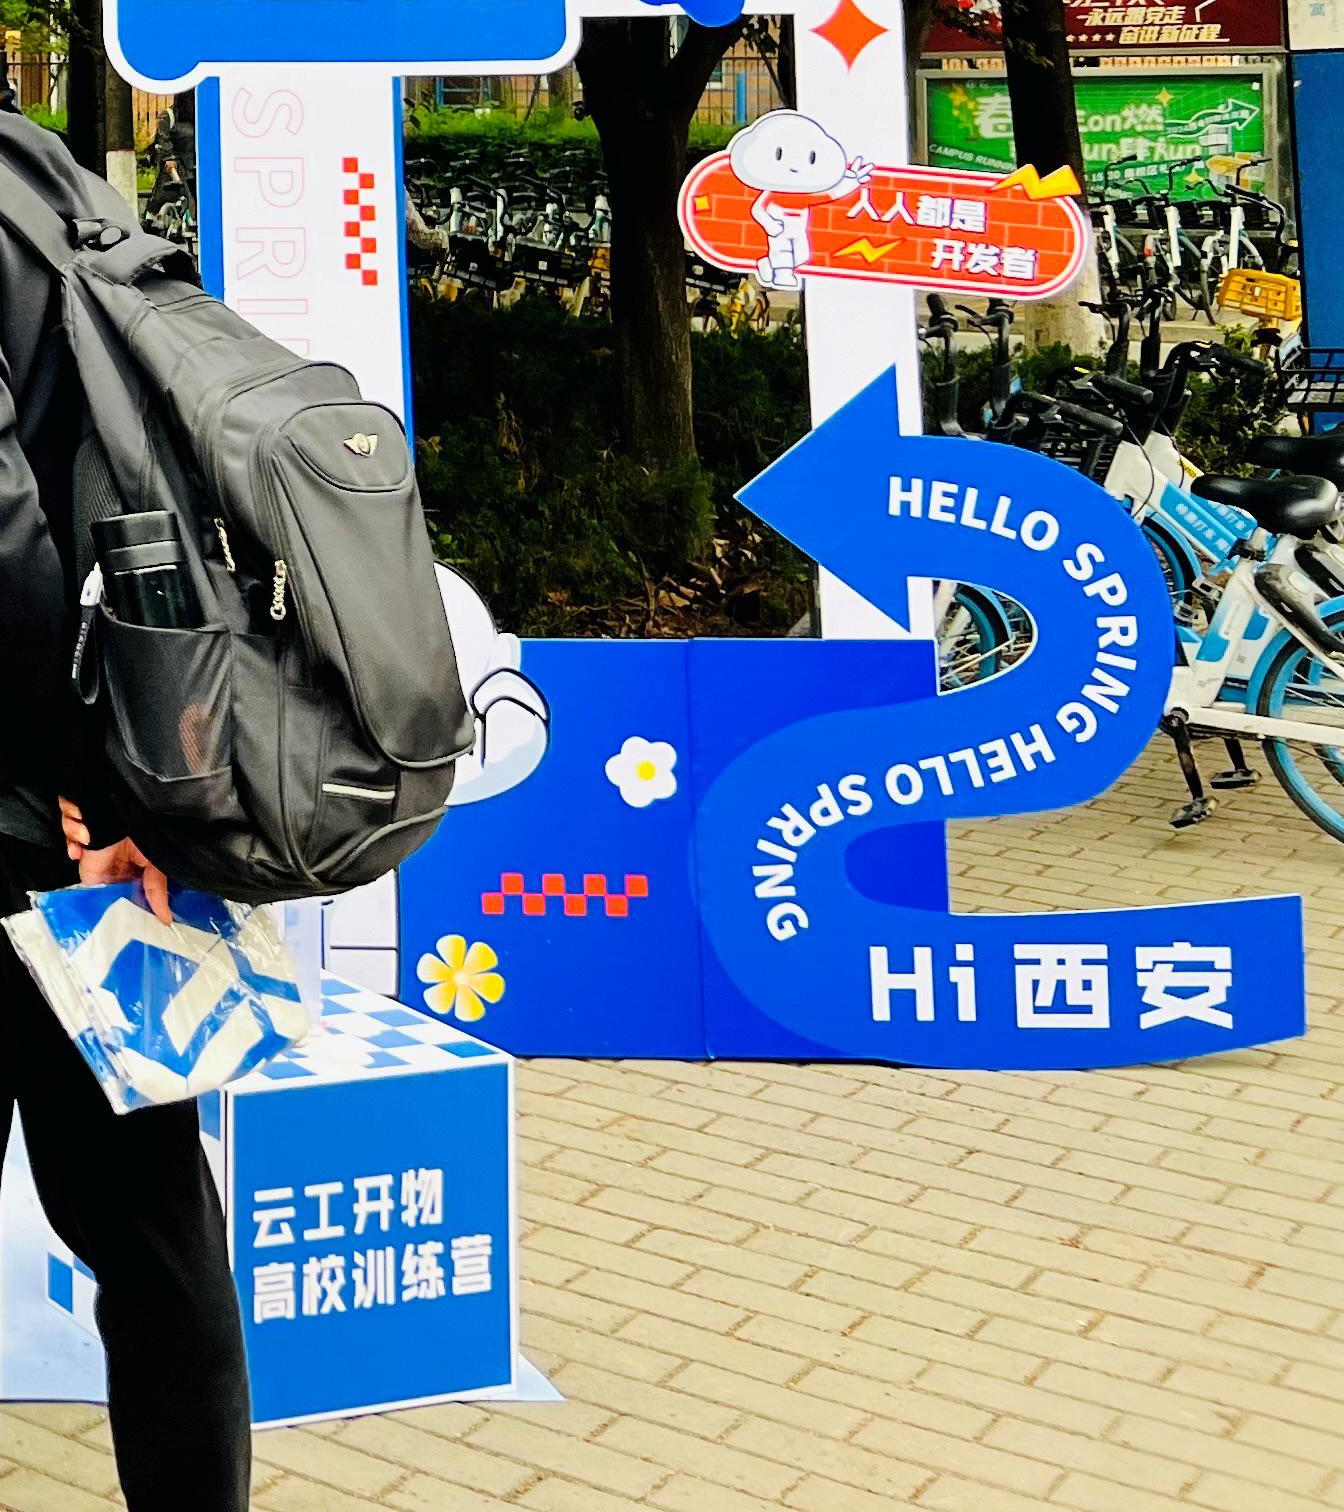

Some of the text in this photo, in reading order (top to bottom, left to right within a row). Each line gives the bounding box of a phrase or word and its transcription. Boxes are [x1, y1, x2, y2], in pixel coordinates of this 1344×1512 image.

[231, 87, 310, 355] SPRI
[846, 188, 987, 233] 人人都是
[931, 238, 1038, 281] 开发者
[752, 476, 1139, 942] HELLO SPRING HELLO SPRING
[869, 941, 1234, 1030] Hi 西安
[252, 1167, 444, 1248] 云工开物
[252, 1233, 493, 1324] 高校训练营
